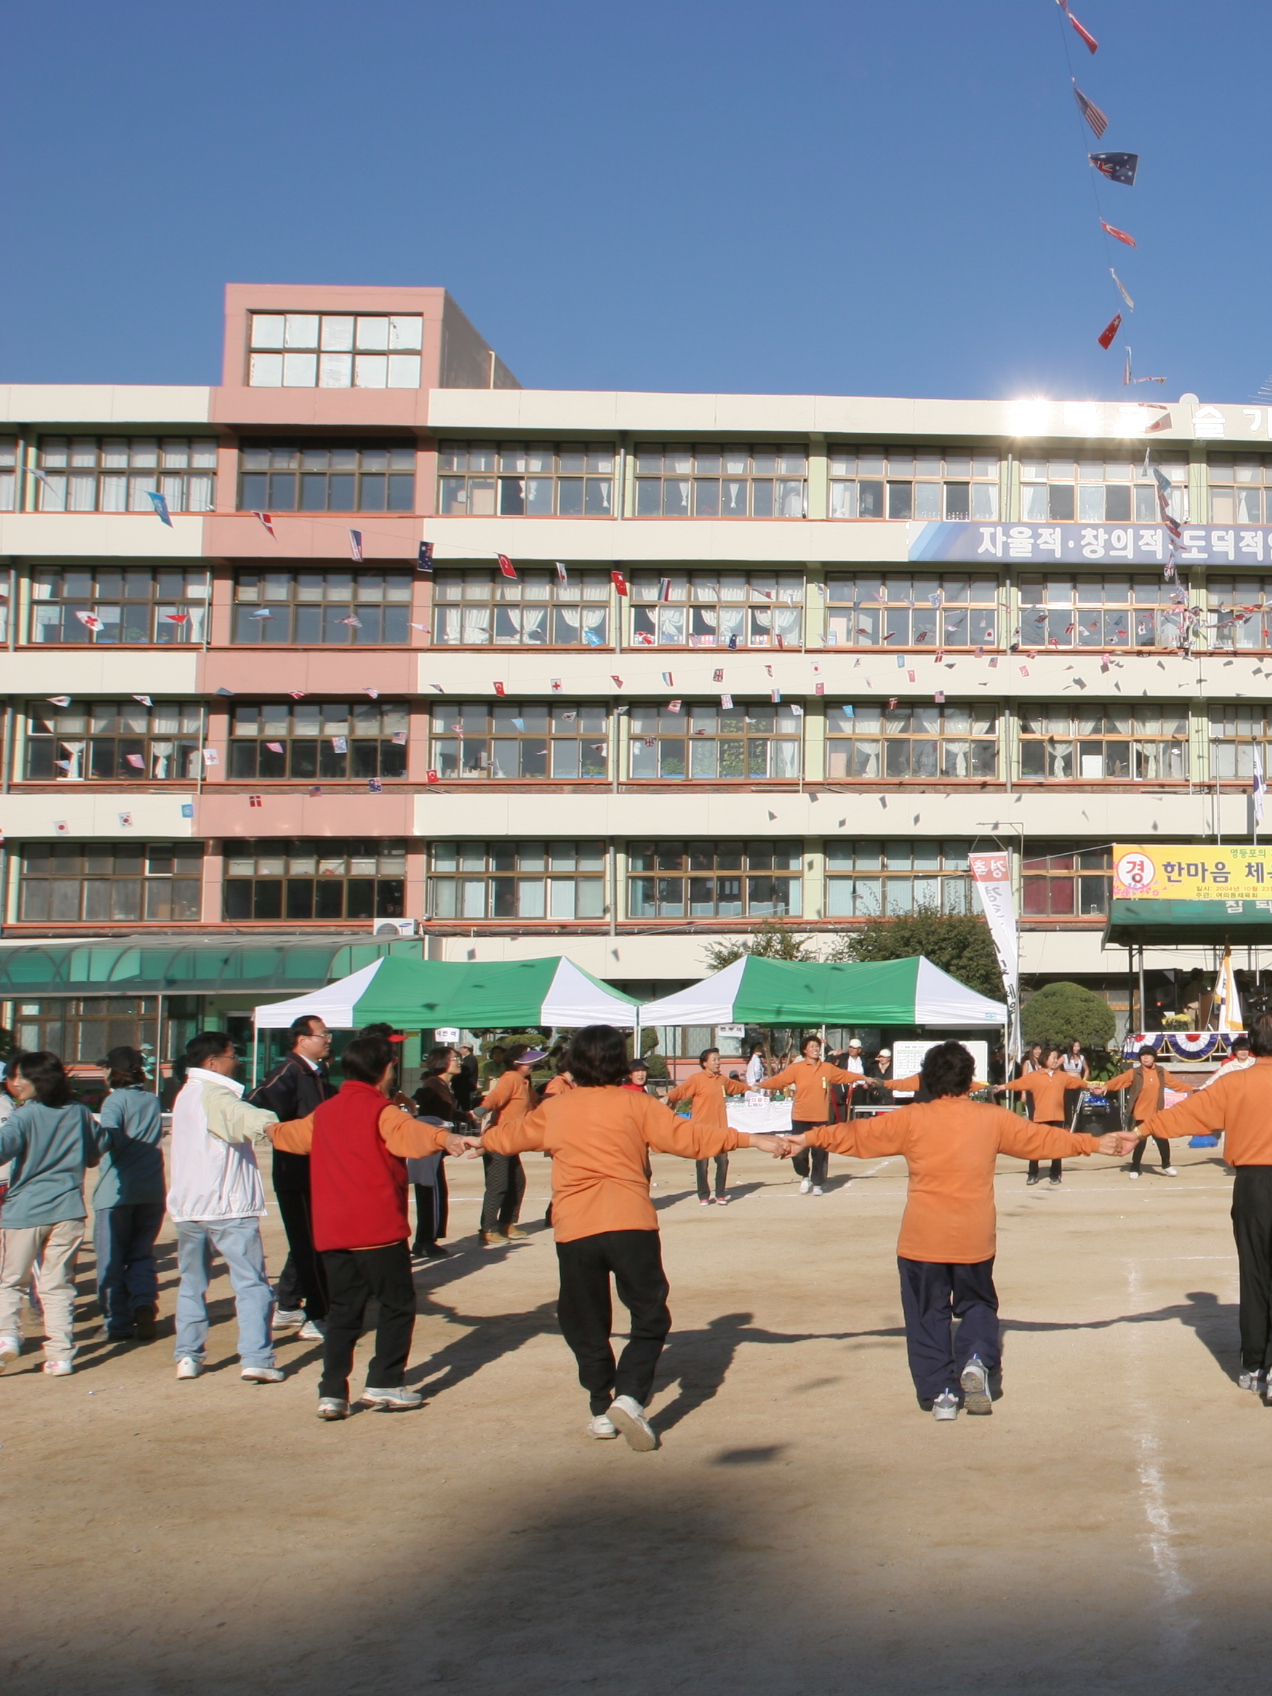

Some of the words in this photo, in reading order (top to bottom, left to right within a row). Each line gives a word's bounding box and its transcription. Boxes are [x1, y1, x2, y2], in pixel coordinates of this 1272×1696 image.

[1230, 849, 1267, 859] 영등포의
[1125, 860, 1146, 884] 경
[1162, 861, 1232, 884] 한마음
